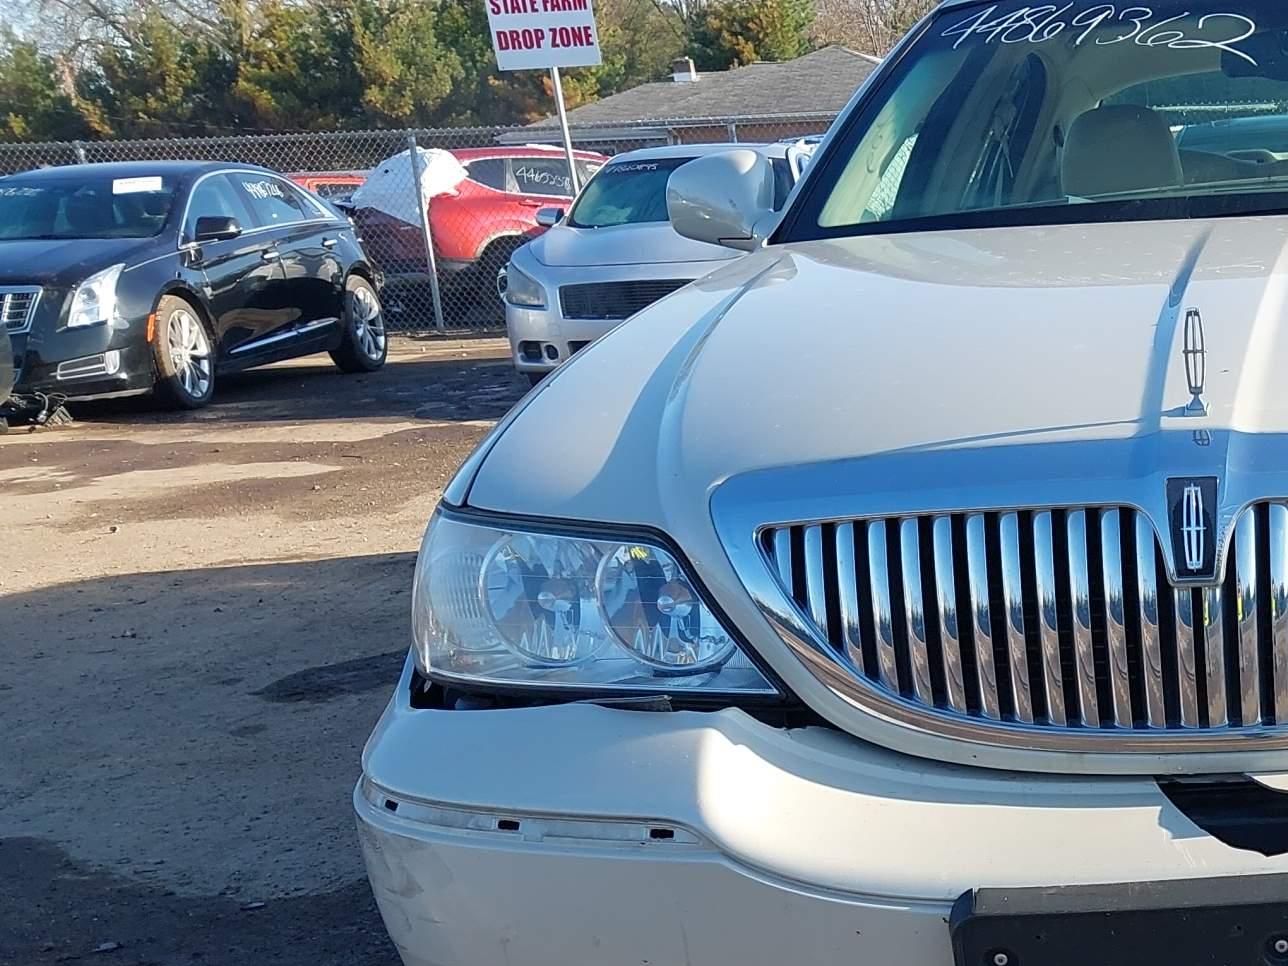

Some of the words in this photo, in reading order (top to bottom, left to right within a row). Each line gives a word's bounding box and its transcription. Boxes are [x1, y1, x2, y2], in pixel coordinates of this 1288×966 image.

[489, 0, 540, 15] STATE
[496, 28, 545, 51] DROP
[548, 26, 594, 48] ZONE
[941, 2, 1258, 66] 44869362
